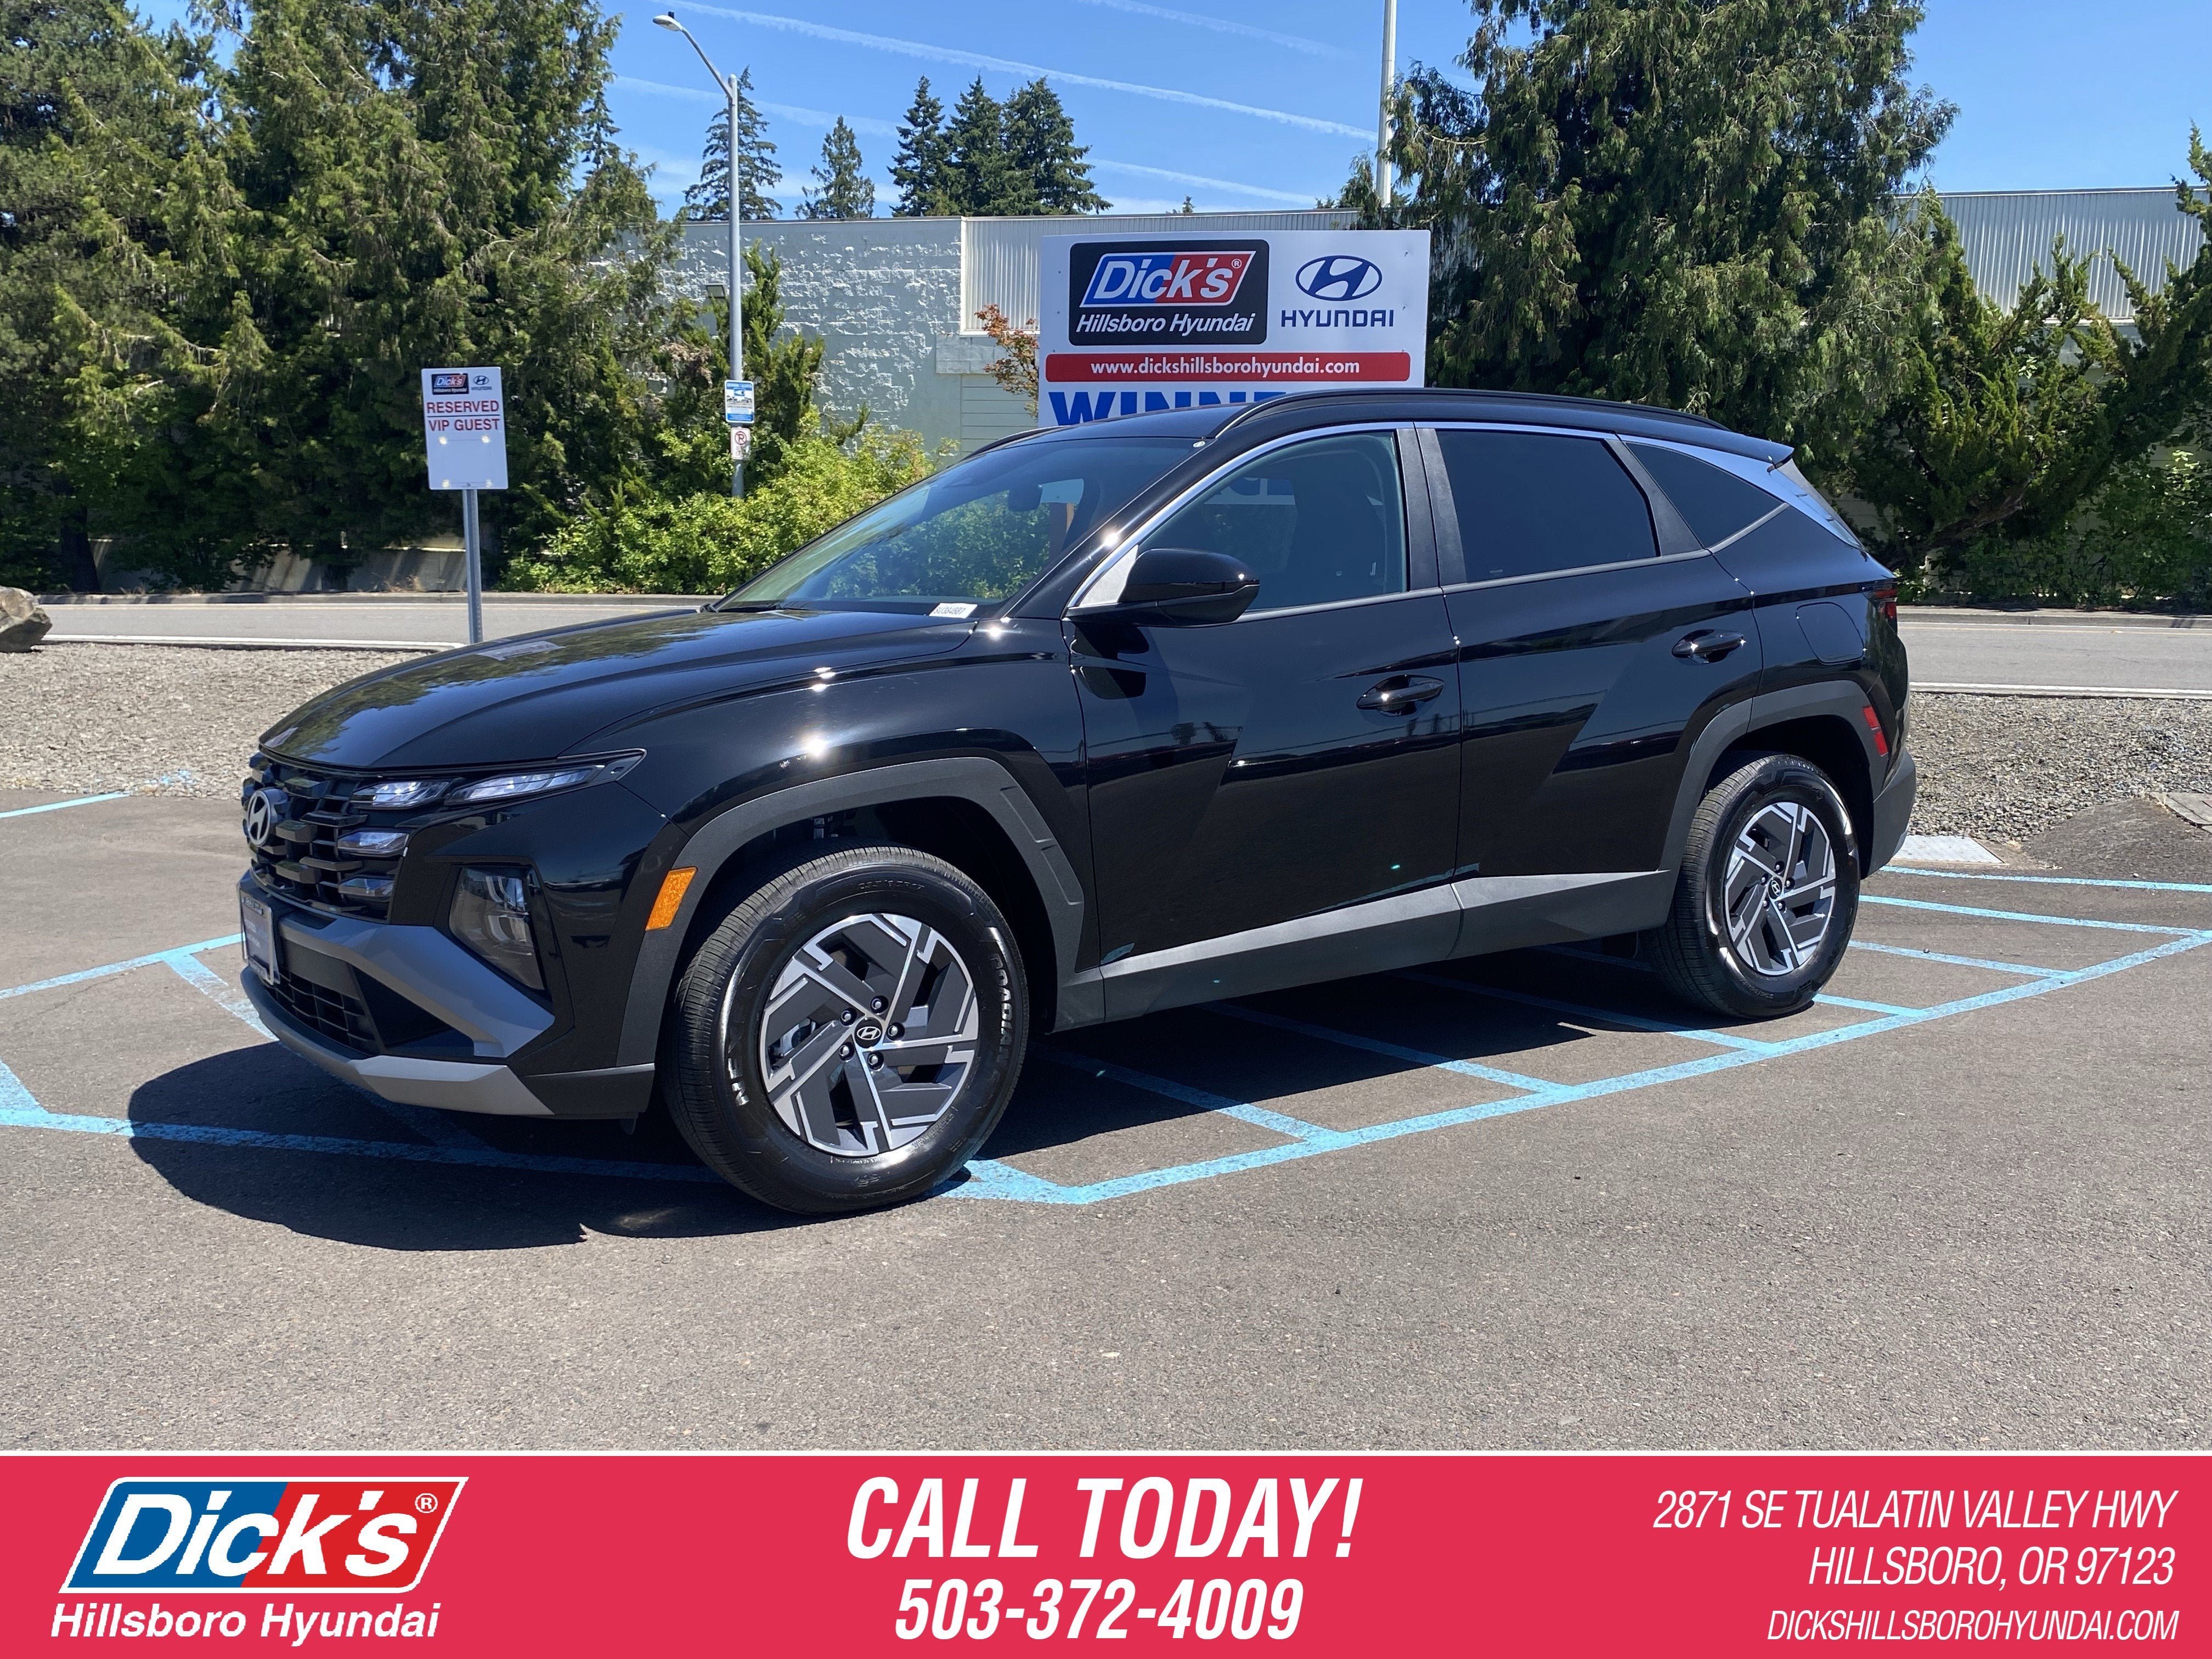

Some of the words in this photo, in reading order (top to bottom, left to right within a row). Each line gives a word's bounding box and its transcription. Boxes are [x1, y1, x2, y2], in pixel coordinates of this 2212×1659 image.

[1093, 257, 1233, 300] Dick's
[1076, 313, 1166, 332] Hillsboro
[1169, 313, 1256, 336] Hyundai
[1281, 309, 1394, 328] HYUNDAI
[1091, 356, 1359, 379] www.dickshillsborohyundai.com
[426, 400, 500, 414] RESERVED
[428, 420, 450, 432] VIP
[454, 418, 500, 431] GUEST
